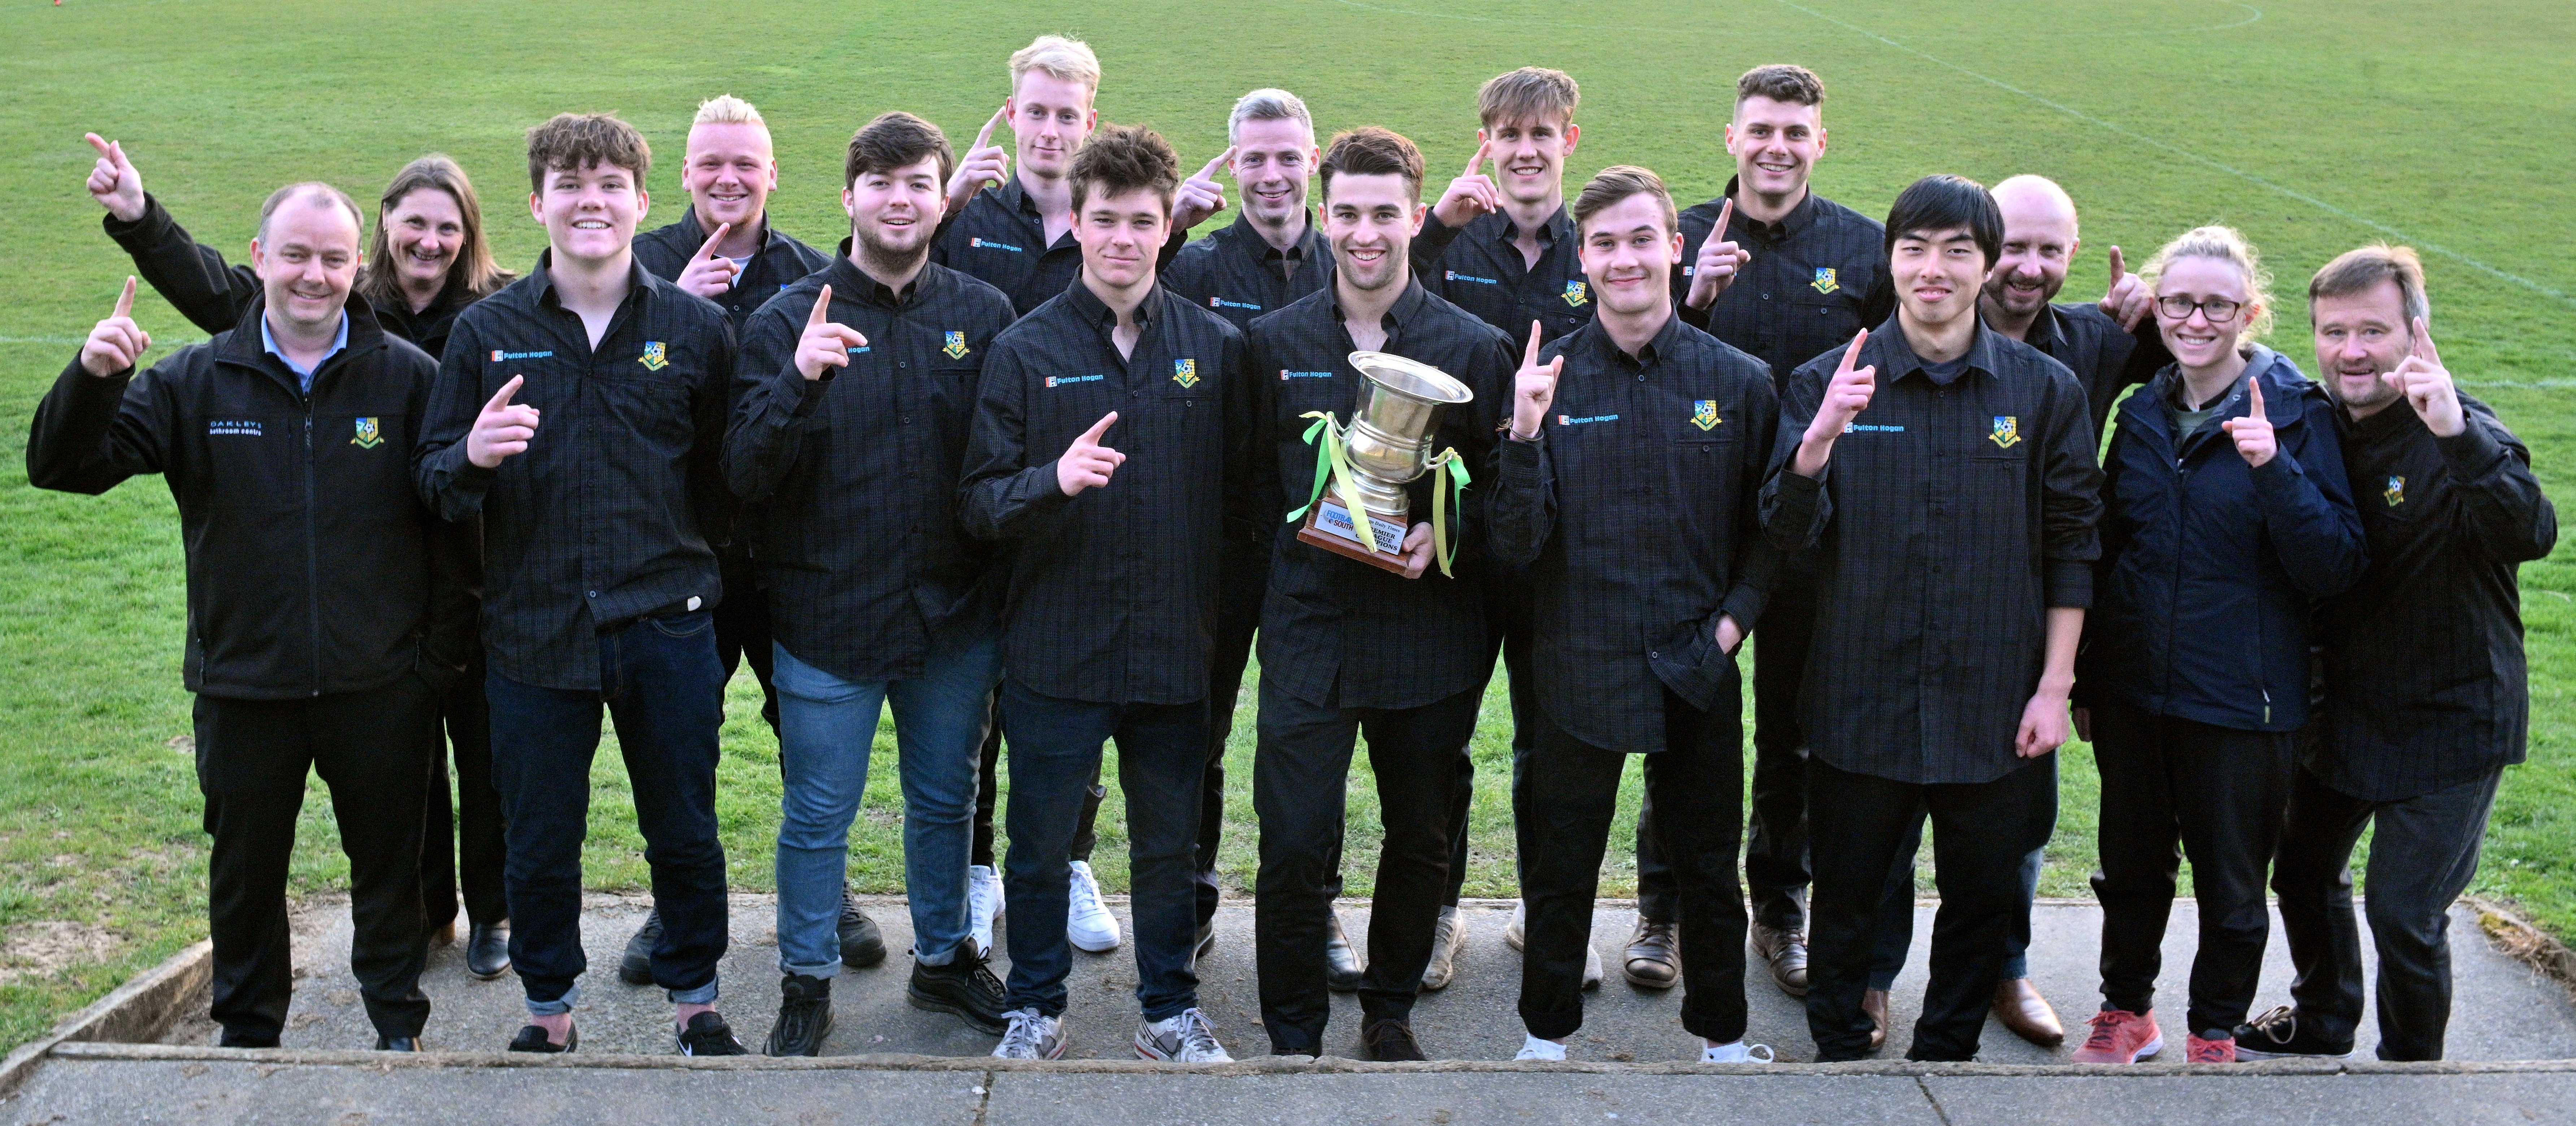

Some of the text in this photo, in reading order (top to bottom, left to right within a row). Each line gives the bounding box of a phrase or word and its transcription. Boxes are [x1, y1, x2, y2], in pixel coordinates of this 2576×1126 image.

[1002, 243, 1022, 252] Hogan
[1327, 510, 1354, 525] FOOTBAL
[1334, 520, 1353, 531] SOUTH
[1371, 527, 1395, 539] REMIER
[1374, 534, 1392, 543] AGUE
